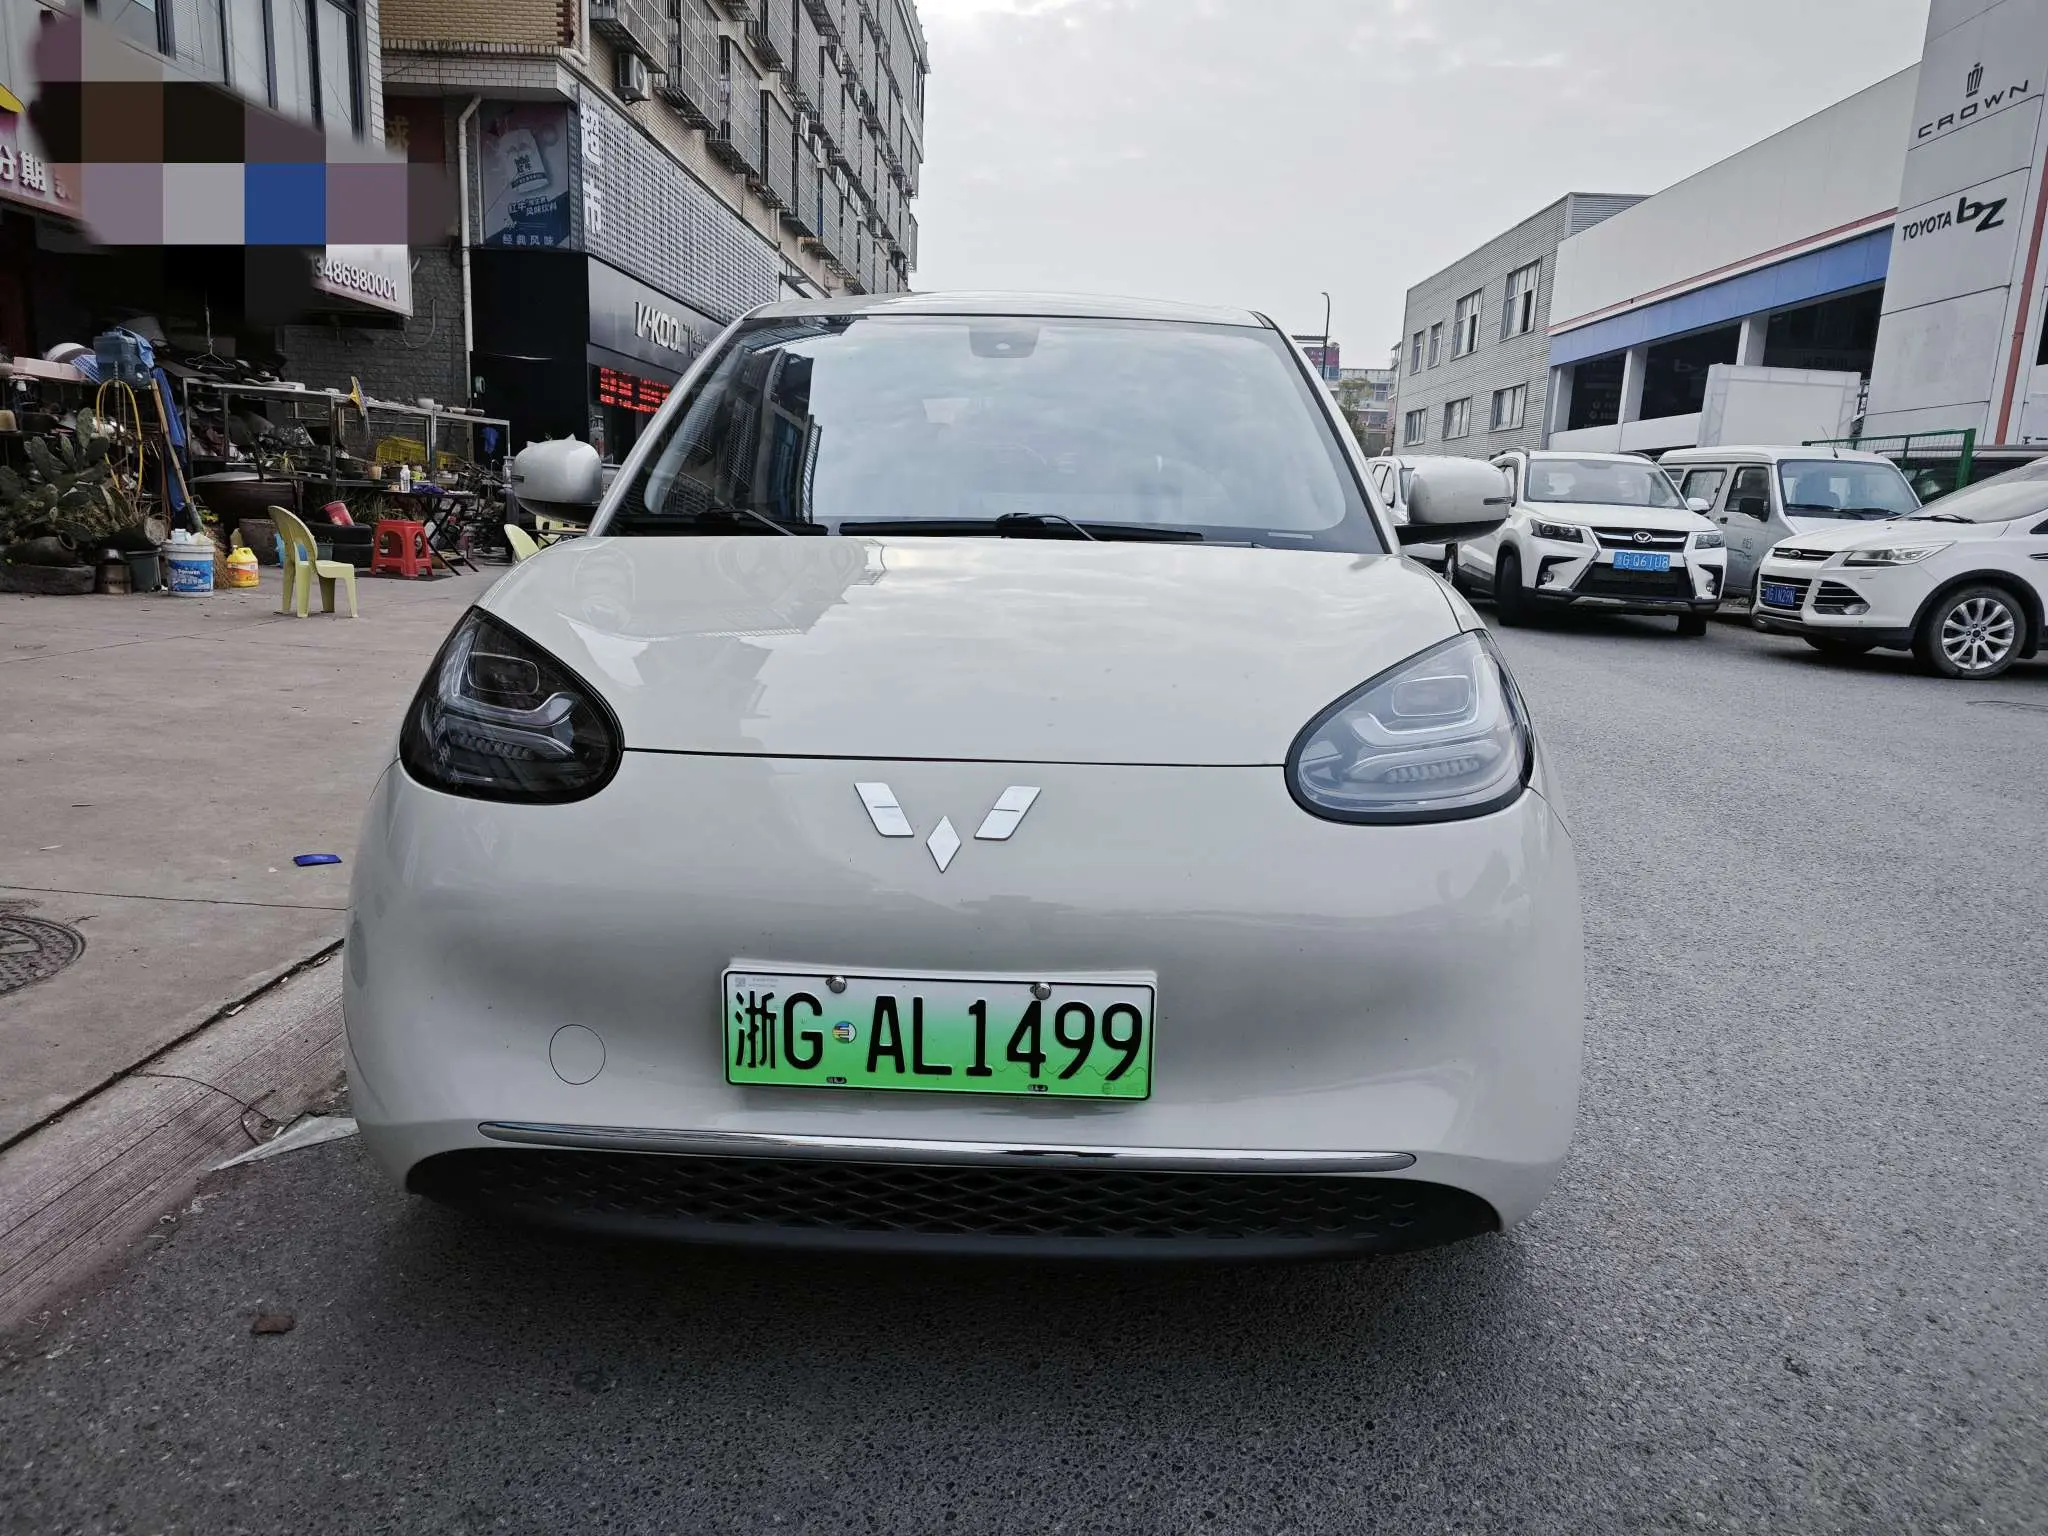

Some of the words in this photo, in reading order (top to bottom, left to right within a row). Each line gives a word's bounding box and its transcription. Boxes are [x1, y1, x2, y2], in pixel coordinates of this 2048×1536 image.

[1917, 79, 2029, 139] CROWN
[1902, 211, 1952, 242] TOYOTA
[734, 991, 824, 1071] 浙G
[866, 995, 1143, 1082] AL1499
